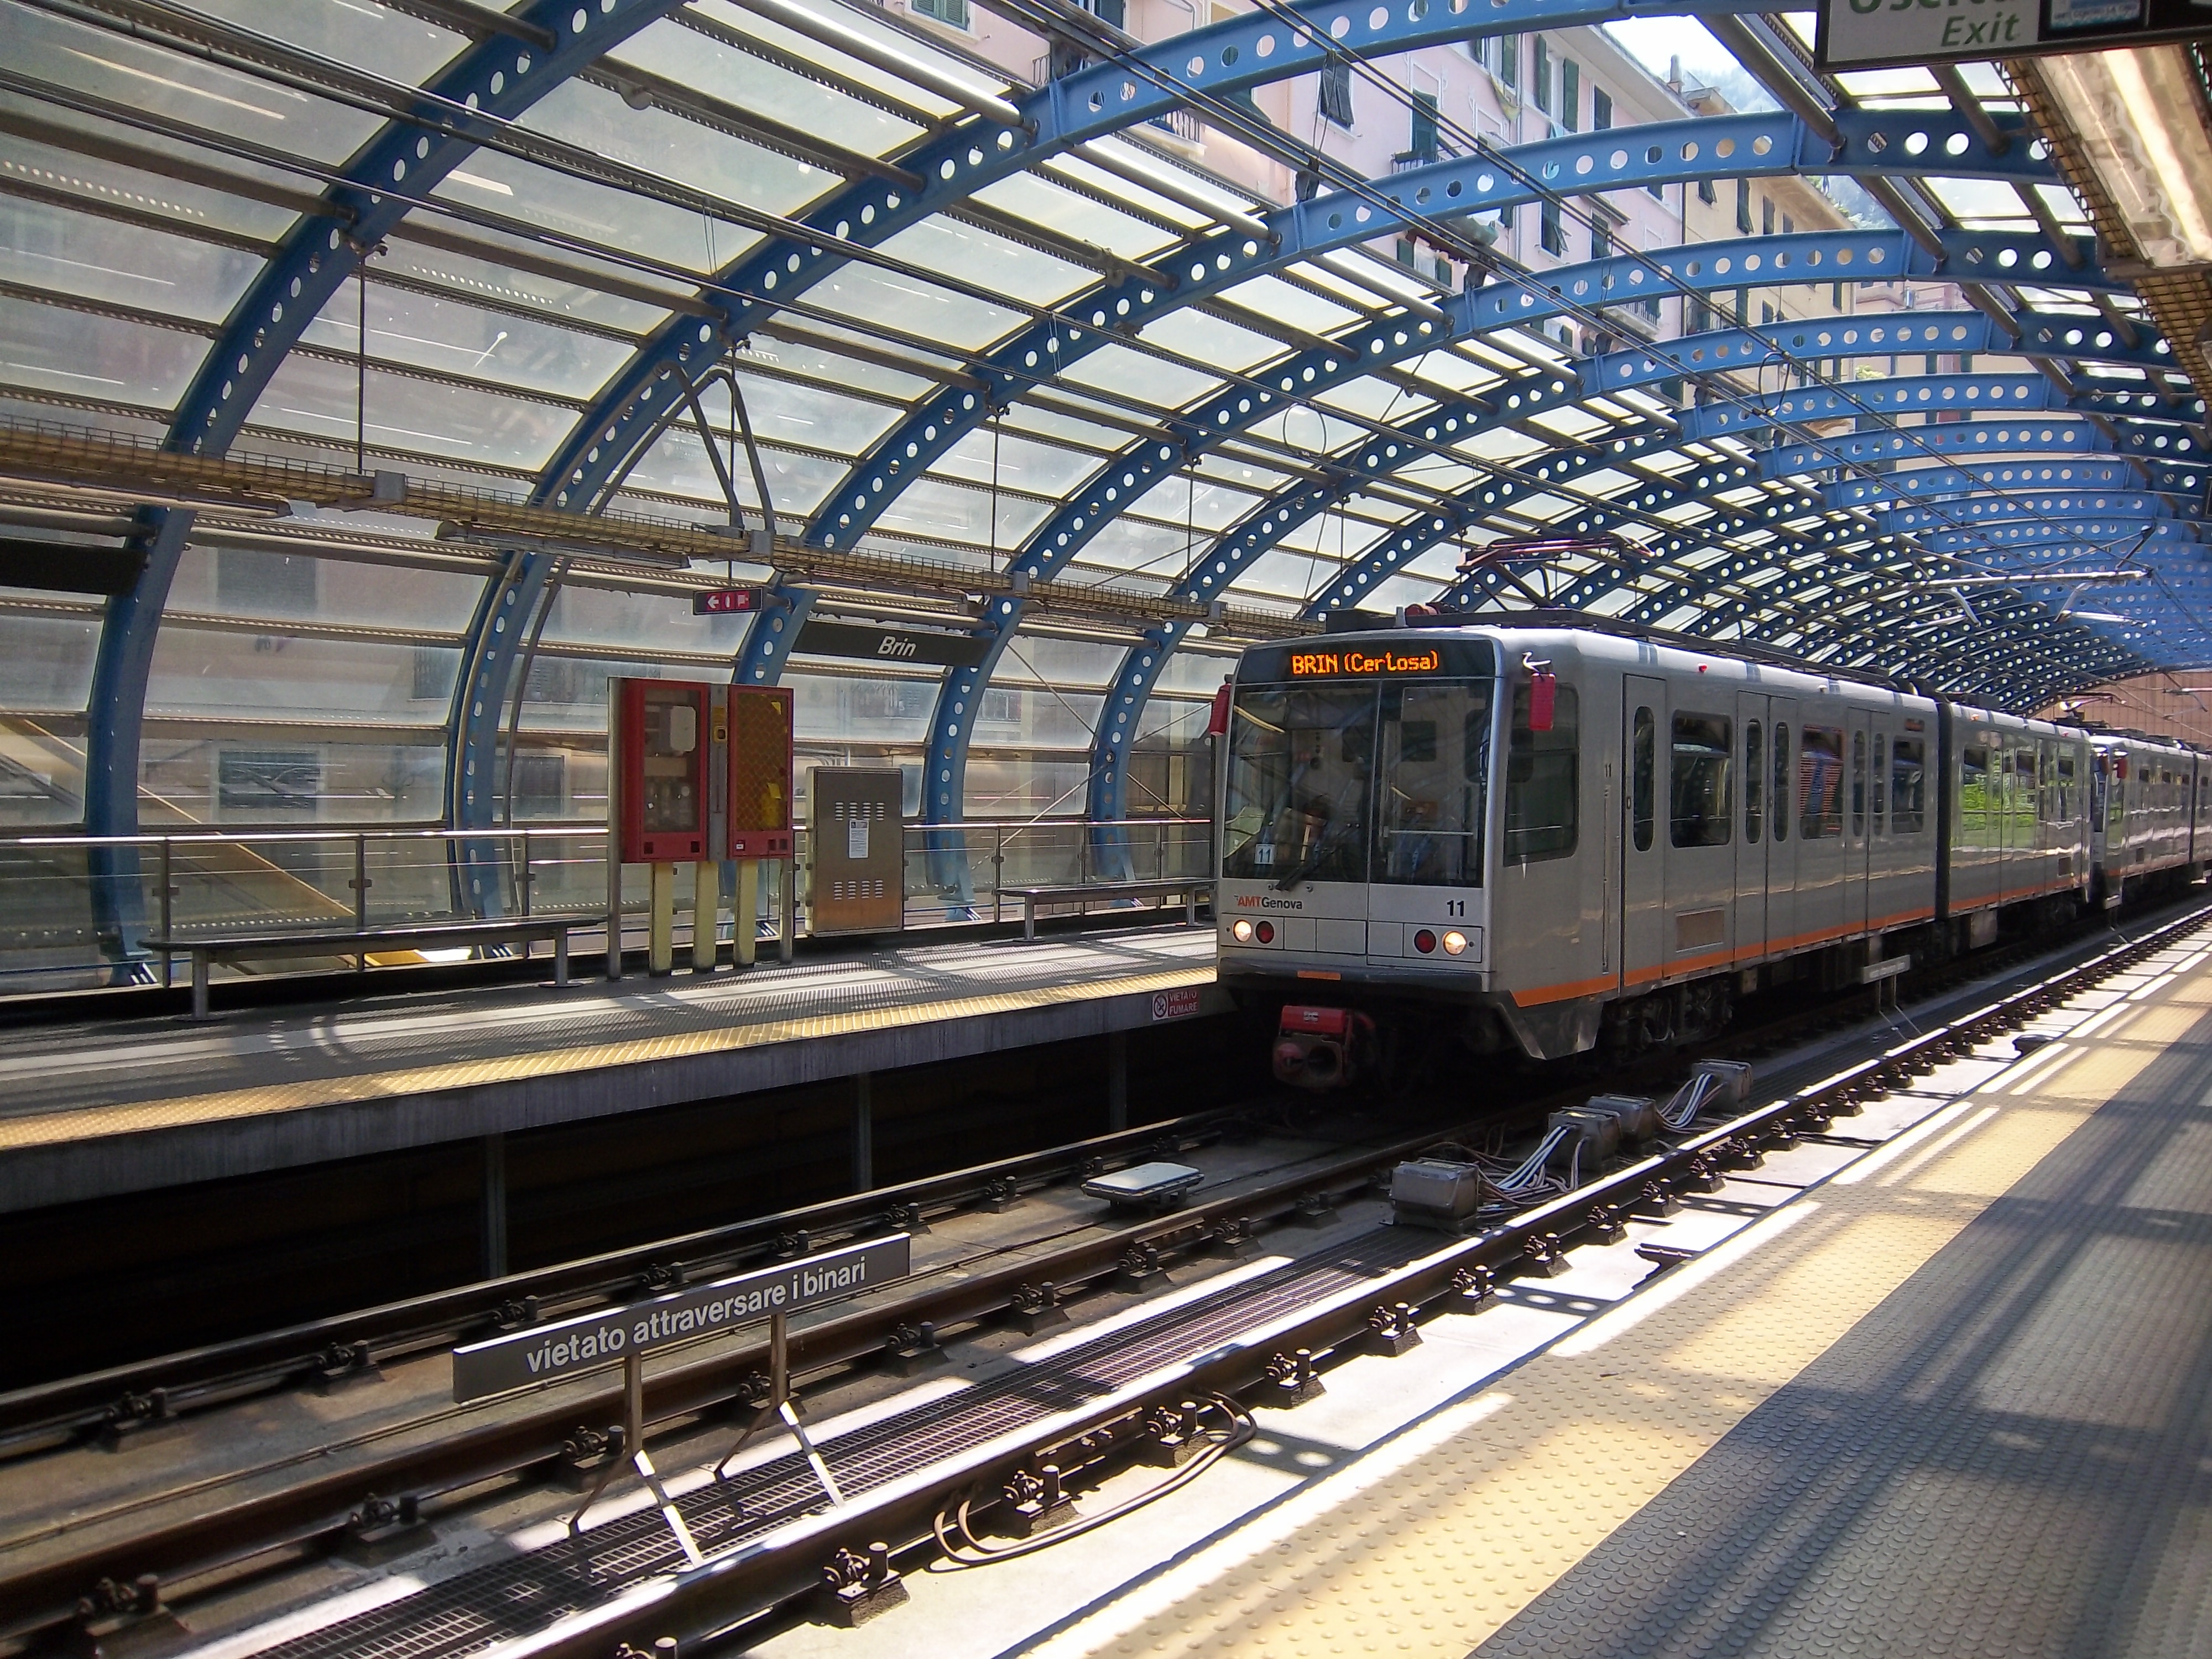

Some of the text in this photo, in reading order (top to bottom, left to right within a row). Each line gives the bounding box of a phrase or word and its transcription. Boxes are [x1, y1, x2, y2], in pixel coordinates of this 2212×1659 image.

[1942, 12, 2020, 47] Exit
[877, 636, 916, 656] Brin
[1291, 649, 1439, 674] BRIN (Certosa)
[1258, 848, 1271, 863] 11
[1447, 900, 1464, 917] 11
[1168, 992, 1197, 1002] VIETATO
[1169, 1001, 1198, 1015] FUMARE
[526, 1256, 867, 1373] vietato attraversare i binari
